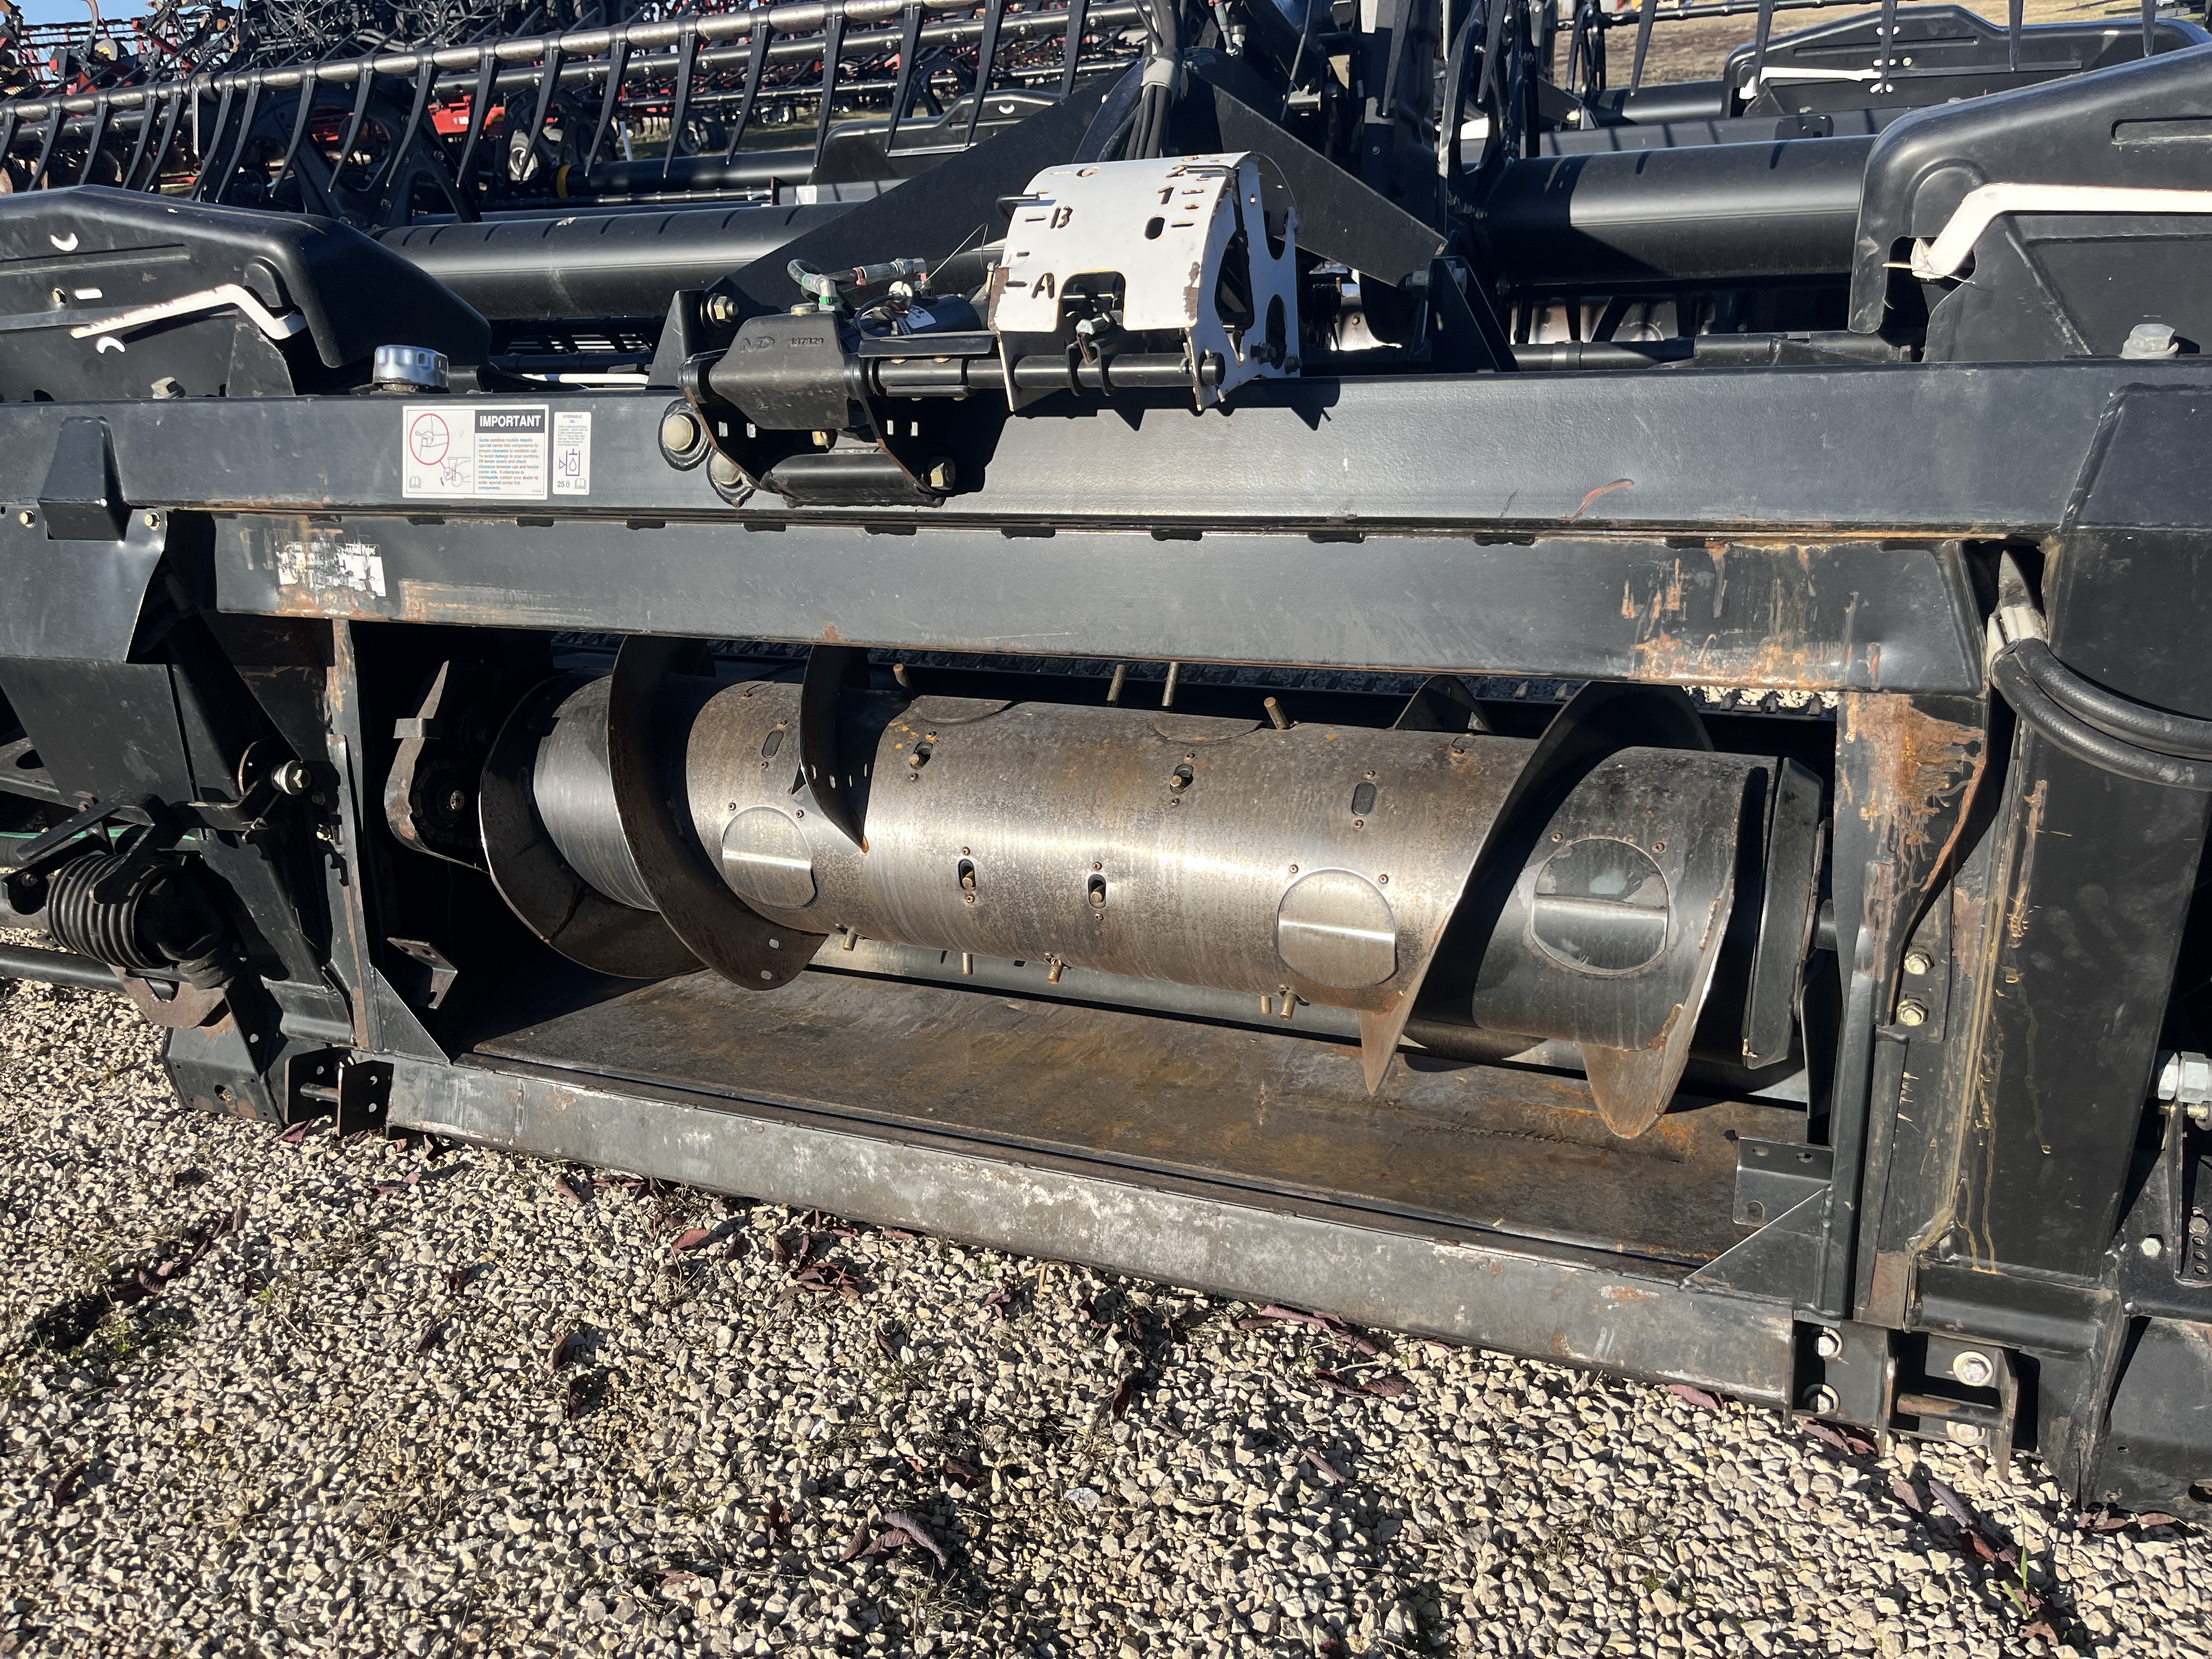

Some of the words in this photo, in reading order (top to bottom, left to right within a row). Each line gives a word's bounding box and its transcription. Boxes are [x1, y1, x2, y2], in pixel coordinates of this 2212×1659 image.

[1158, 184, 1176, 205] 1
[1050, 206, 1073, 229] B
[1031, 272, 1055, 300] A
[479, 415, 541, 427] IMPORTANT
